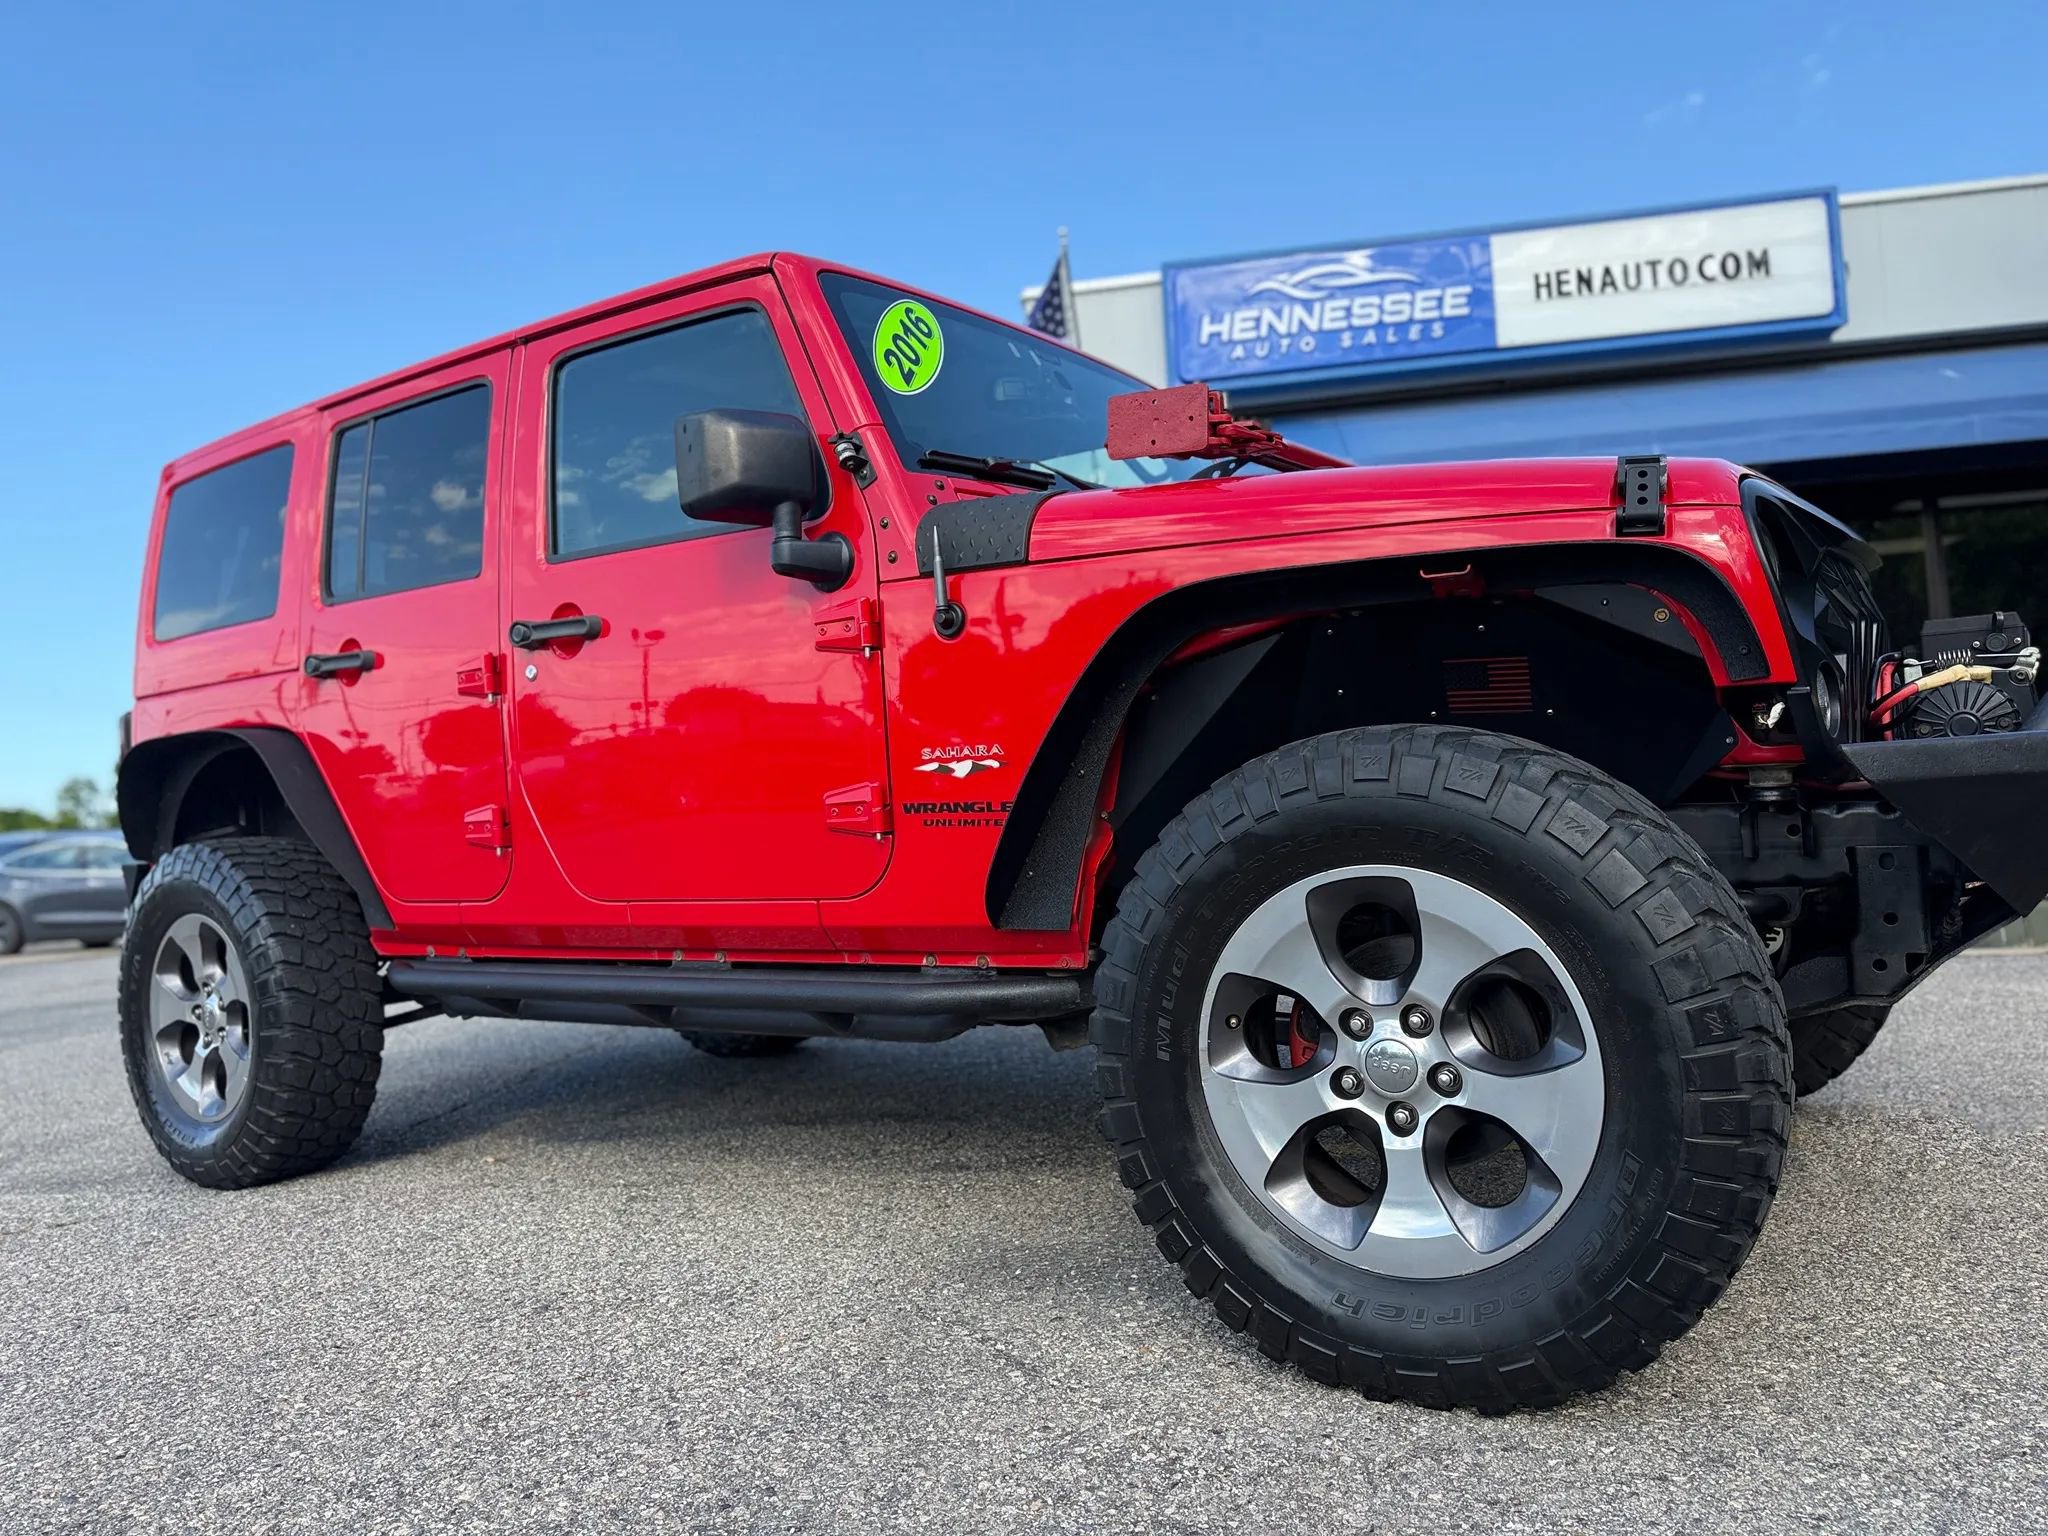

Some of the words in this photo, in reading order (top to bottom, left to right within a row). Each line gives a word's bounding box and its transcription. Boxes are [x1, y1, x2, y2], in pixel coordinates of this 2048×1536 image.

[1200, 285, 1473, 344] HENNESSEE
[883, 306, 934, 388] 2016
[1229, 335, 1317, 360] AUTO
[1338, 321, 1446, 348] SALES
[921, 744, 1004, 760] SAHARA
[902, 801, 1014, 815] WRANGLE
[923, 819, 1004, 828] UNLIMITE
[1564, 816, 1591, 837] T/A
[1653, 903, 1676, 928] T/A
[1372, 1055, 1412, 1080] Jeep
[1331, 1148, 1645, 1331] BFGoodrich
